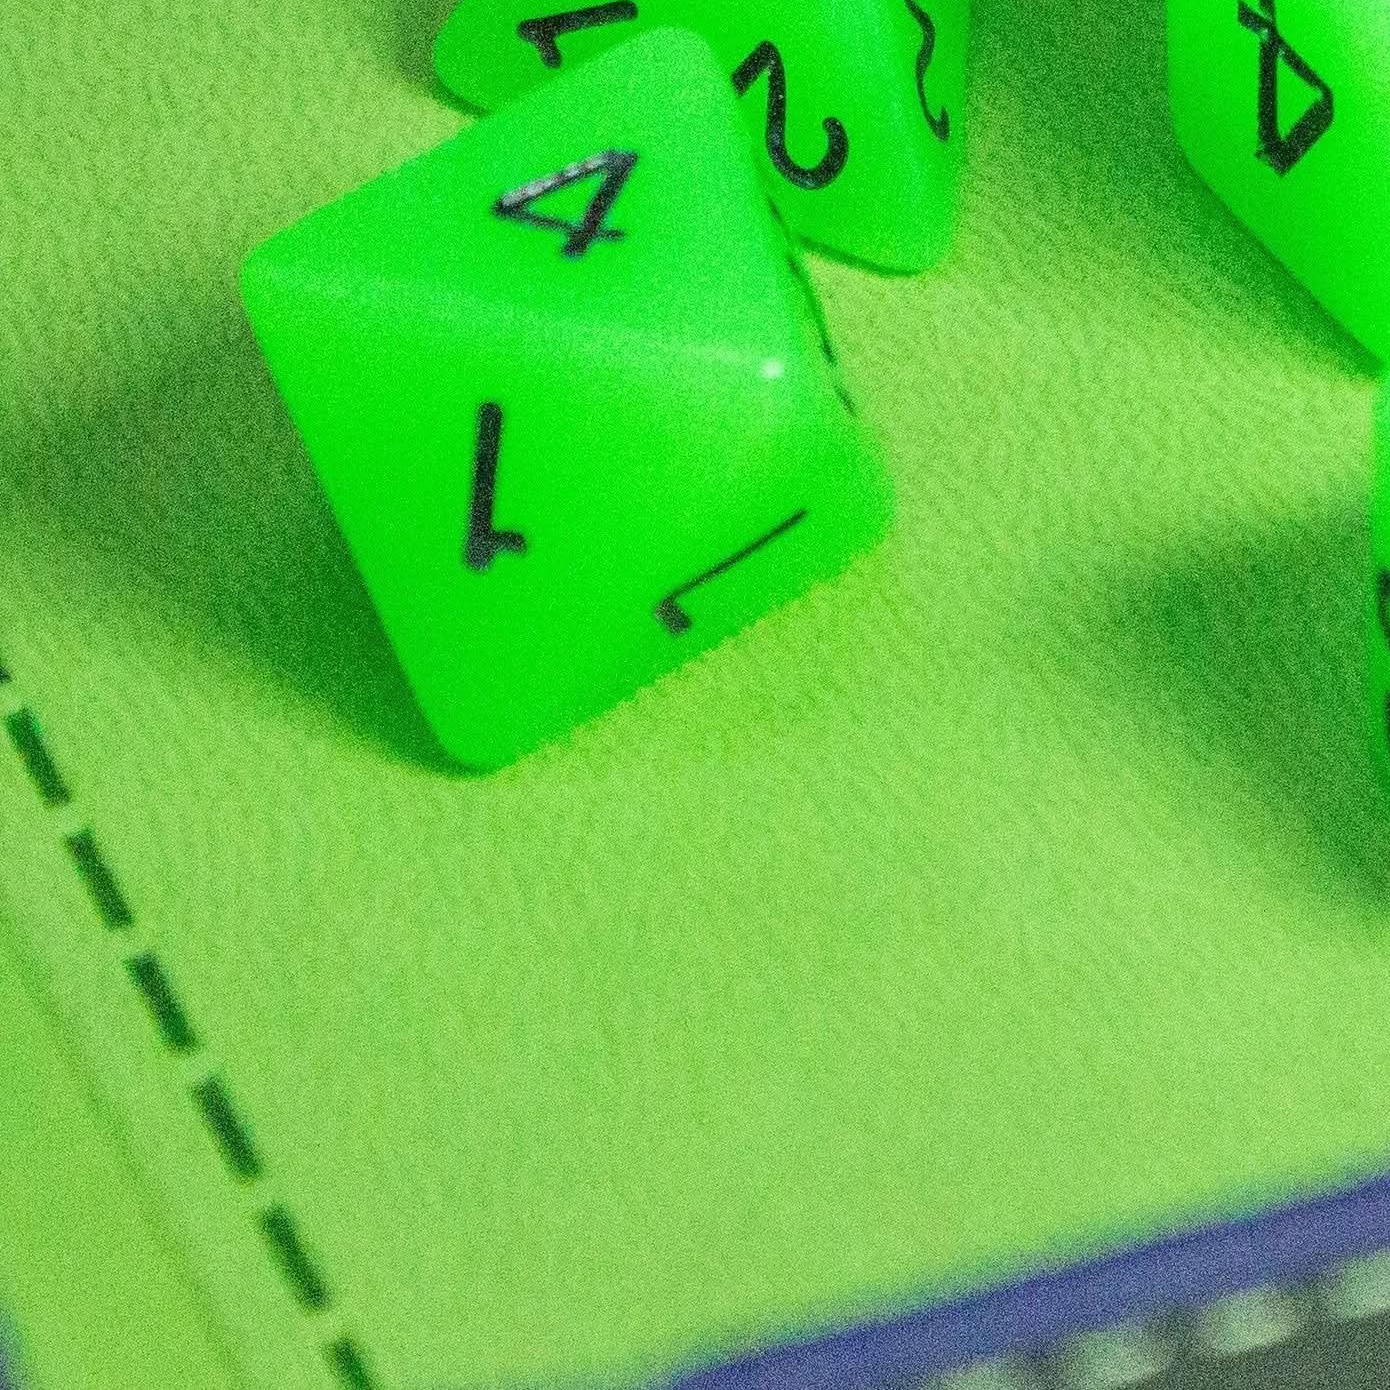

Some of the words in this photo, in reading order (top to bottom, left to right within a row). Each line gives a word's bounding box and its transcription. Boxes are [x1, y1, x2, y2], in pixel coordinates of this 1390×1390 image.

[731, 40, 849, 190] 2
[492, 150, 638, 258] 4
[464, 402, 526, 570] 1
